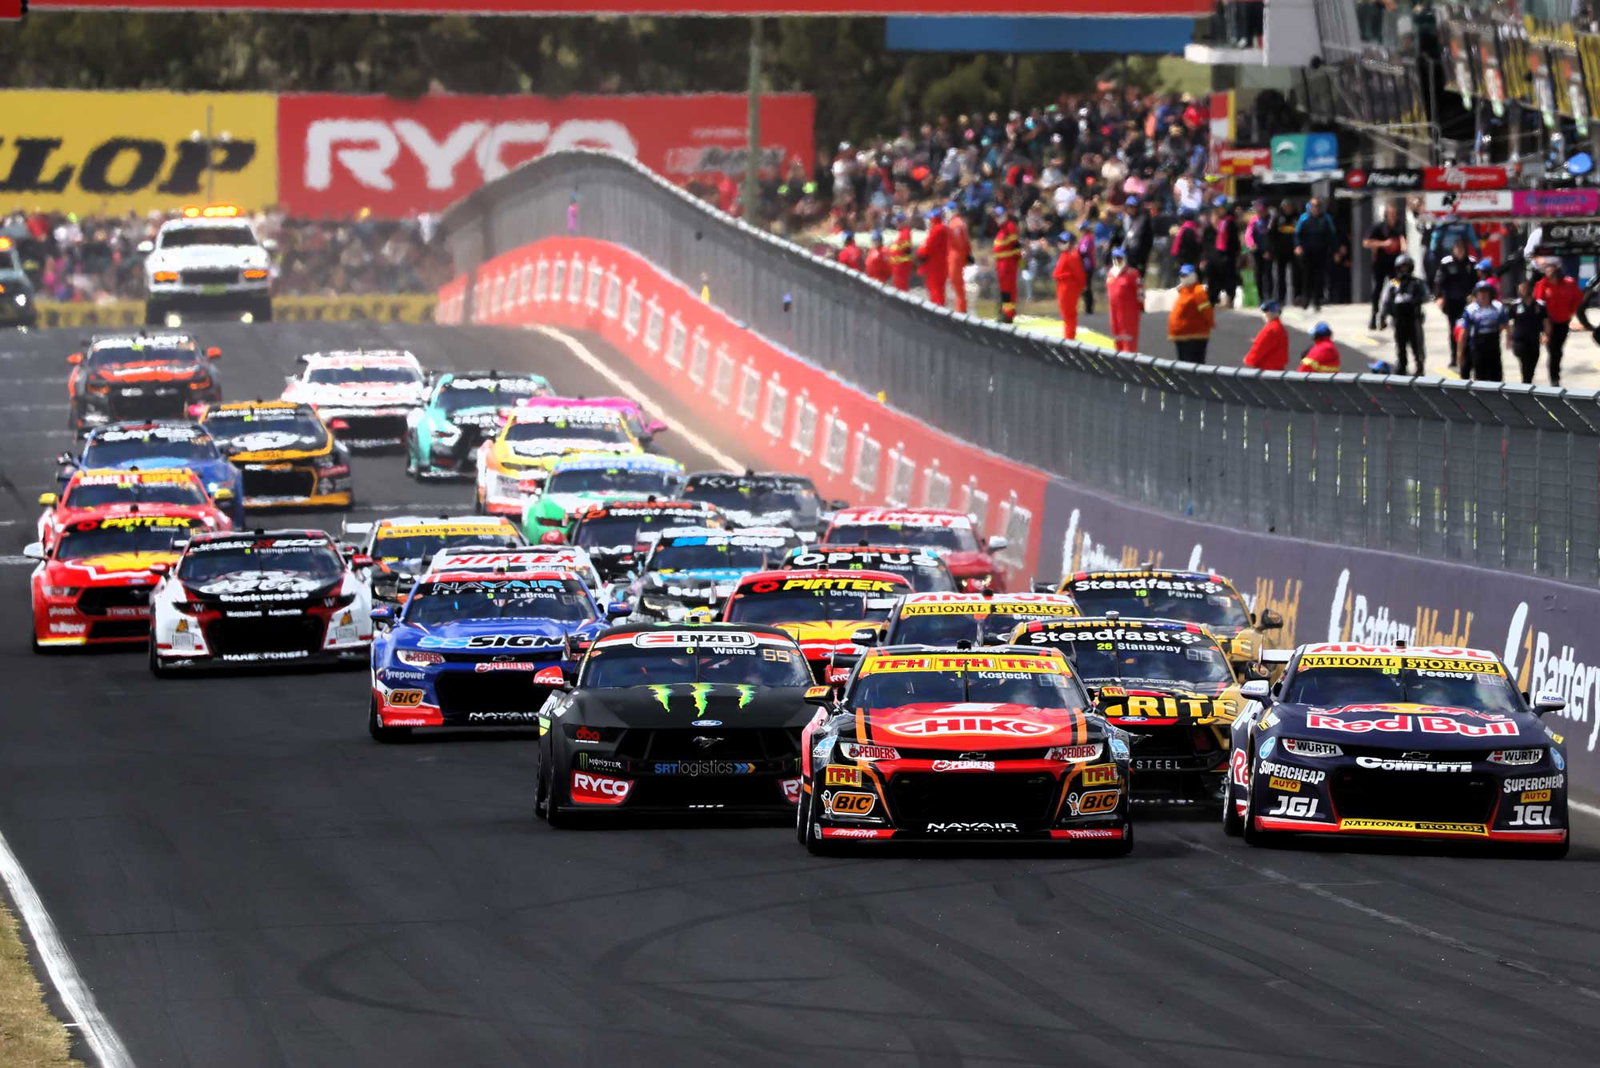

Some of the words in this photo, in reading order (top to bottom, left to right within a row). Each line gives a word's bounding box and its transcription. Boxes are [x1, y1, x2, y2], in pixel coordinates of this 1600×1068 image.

[0, 136, 256, 195] LOP
[447, 555, 576, 565] HIFLEX
[793, 553, 938, 566] OPTUS
[432, 581, 563, 591] NAVAIR
[783, 579, 894, 592] PIRTEK
[1075, 578, 1196, 592] Steadfast
[514, 592, 557, 600] LeBrocq
[843, 590, 880, 598] Pasqale
[1135, 589, 1147, 597] 19
[1168, 590, 1203, 599] Payne
[906, 605, 986, 614] NATIONAL
[996, 605, 1074, 615] STORAGE
[677, 634, 745, 644] ENZED
[1031, 629, 1171, 643] Steadfast
[686, 647, 694, 655] 6
[712, 647, 757, 656] Waters
[1117, 643, 1181, 654] Stanaway
[876, 659, 924, 669] TFH
[937, 658, 988, 668] TFH
[1002, 658, 1052, 670] TFH
[1303, 657, 1396, 667] NATIONAL
[1406, 658, 1496, 673] STORAGE
[386, 670, 426, 680] Tyrepower
[535, 676, 564, 684] RYCO
[978, 671, 1032, 680] Kostecki
[1416, 670, 1474, 681] Feeney
[1105, 697, 1240, 720] RITE
[889, 718, 1050, 735] CHIKO
[1306, 711, 1412, 733] Red
[1418, 716, 1520, 737] Bull
[858, 746, 895, 760] PEDDERS
[1062, 746, 1096, 758] PEDDERS
[1296, 742, 1337, 755] WÜRTH
[1136, 760, 1181, 770] STEEL
[1356, 757, 1472, 772] COMPLETE
[827, 767, 856, 782] TFH
[1084, 766, 1115, 782] TFH
[1259, 760, 1325, 785] SUPERCHEAP
[574, 773, 629, 796] RYCO
[1272, 779, 1298, 790] AUTO
[1503, 774, 1564, 793] SUPERCHEAP
[1524, 792, 1548, 800] AUTO
[1269, 795, 1319, 818] JGI
[1508, 805, 1552, 826] JGI
[927, 822, 1018, 830] NAVAIR
[1343, 820, 1413, 828] NATIONAL
[1420, 823, 1483, 833] STORAGE
